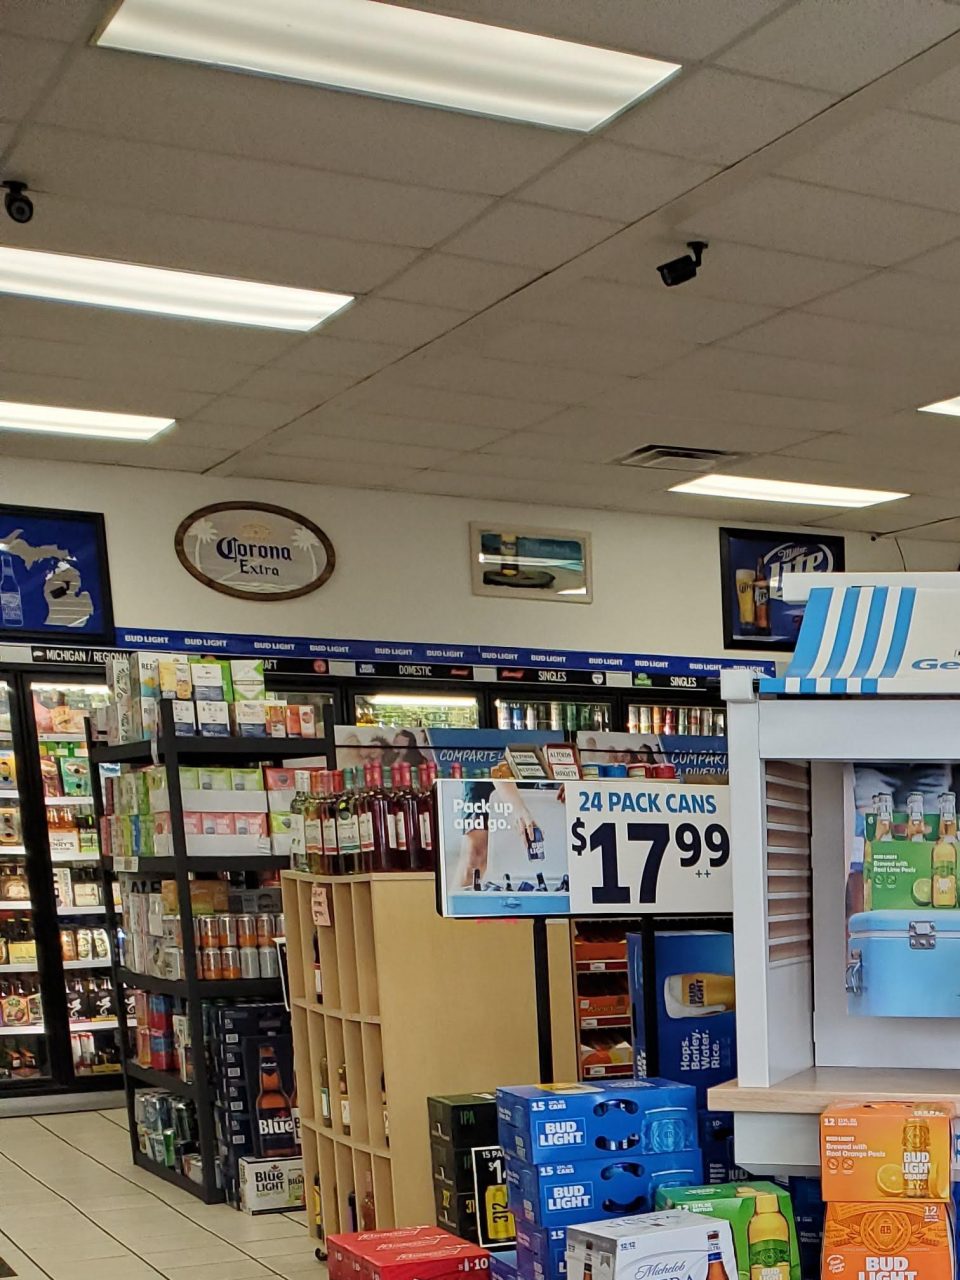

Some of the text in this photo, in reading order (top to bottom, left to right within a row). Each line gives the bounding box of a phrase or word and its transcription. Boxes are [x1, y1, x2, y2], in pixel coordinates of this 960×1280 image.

[216, 536, 292, 561] Corona
[778, 547, 808, 559] Miller
[239, 559, 280, 577] Extra
[125, 634, 169, 644] BUD LIGHT
[46, 649, 86, 662] MICHIGAN
[443, 650, 464, 658] LIGHT
[399, 666, 432, 677] DOMESTIC
[538, 671, 567, 682] SINGLES
[670, 676, 697, 688] SINGLES
[453, 799, 514, 817] Pack up
[579, 791, 717, 814] 24 PACK CANS
[454, 815, 511, 834] and go.
[681, 1037, 690, 1071] Hops.
[691, 1028, 701, 1070] Barley.
[701, 1029, 710, 1069] Water.
[711, 1040, 720, 1069] Rice.
[460, 1110, 475, 1126] IPA
[259, 1119, 293, 1135] Blue
[544, 1121, 577, 1133] BUD
[539, 1132, 584, 1146] LIGHT
[482, 1151, 491, 1159] 15
[904, 1152, 930, 1162] BUD
[255, 1171, 284, 1182] Blue
[256, 1182, 284, 1193] LIGHT
[553, 1185, 585, 1199] BUD
[548, 1196, 591, 1210] LIGHT
[491, 1202, 508, 1223] 312
[923, 1206, 937, 1215] 12
[474, 1258, 489, 1269] 10
[634, 1260, 686, 1280] Michelob
[865, 1256, 909, 1272] BUD
